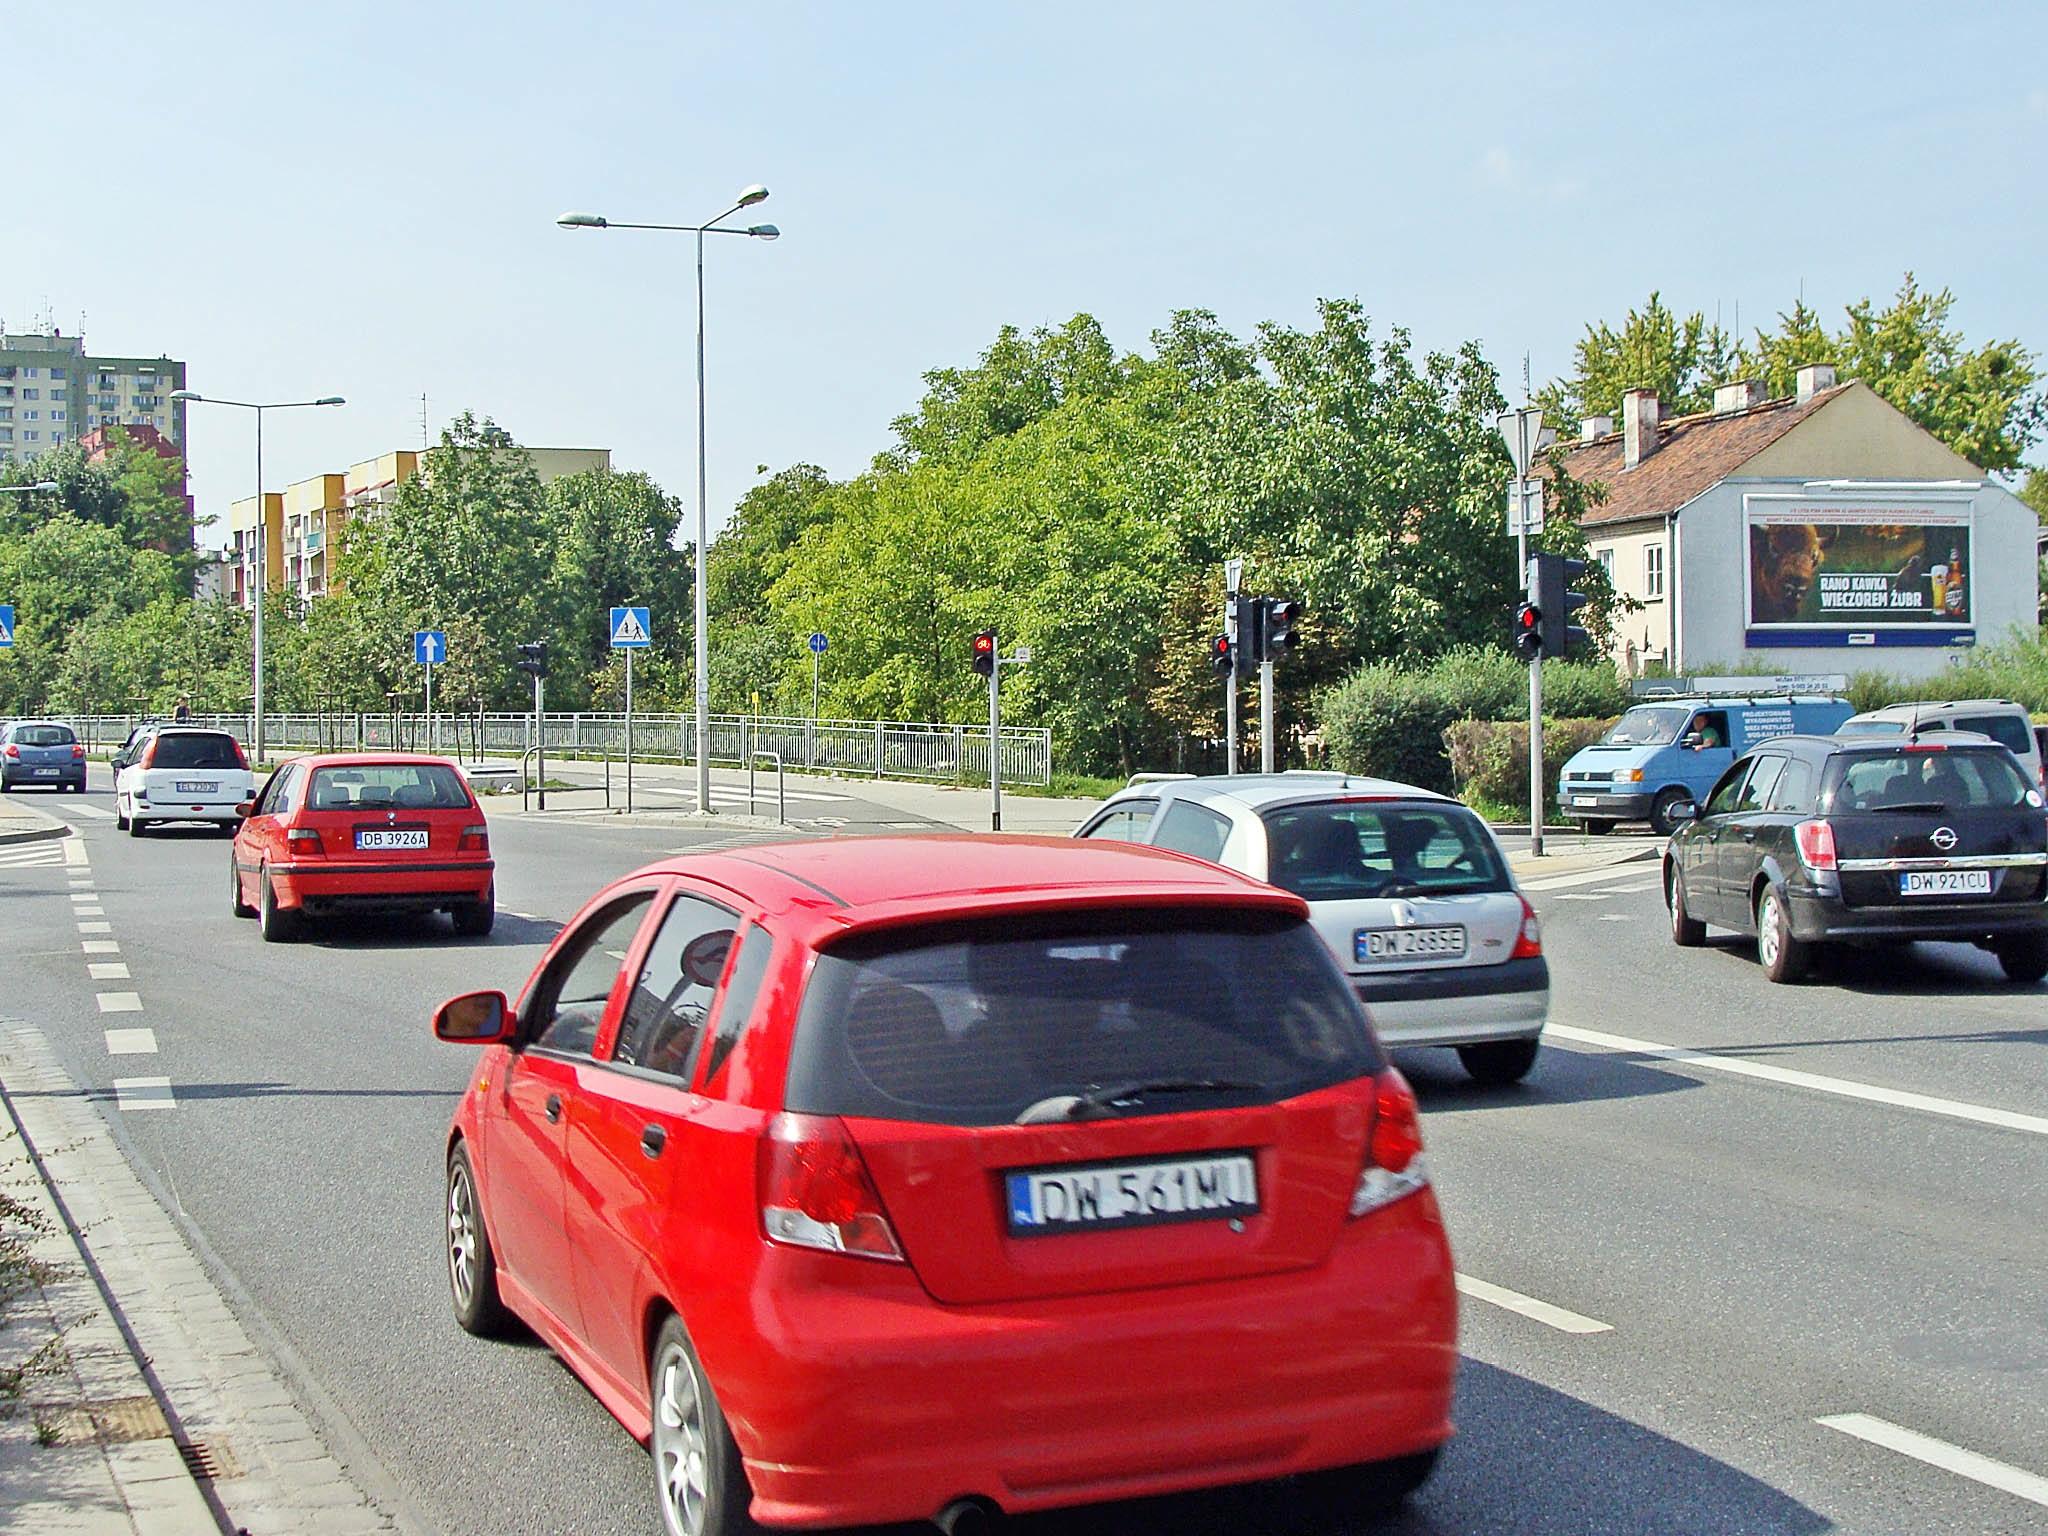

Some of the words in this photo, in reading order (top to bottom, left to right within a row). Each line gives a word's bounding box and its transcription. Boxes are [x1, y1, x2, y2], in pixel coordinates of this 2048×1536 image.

[1821, 577, 1850, 590] RANO
[1852, 577, 1887, 590] KAWKA
[1821, 592, 1887, 607] WIECZOREM
[1890, 589, 1922, 607] ŻUBR
[364, 833, 383, 846] DB
[387, 832, 426, 845] 3926A
[1911, 874, 1933, 890] DW
[1939, 873, 1987, 889] 921CU
[1370, 933, 1399, 954] DW
[1041, 1176, 1101, 1221] DW
